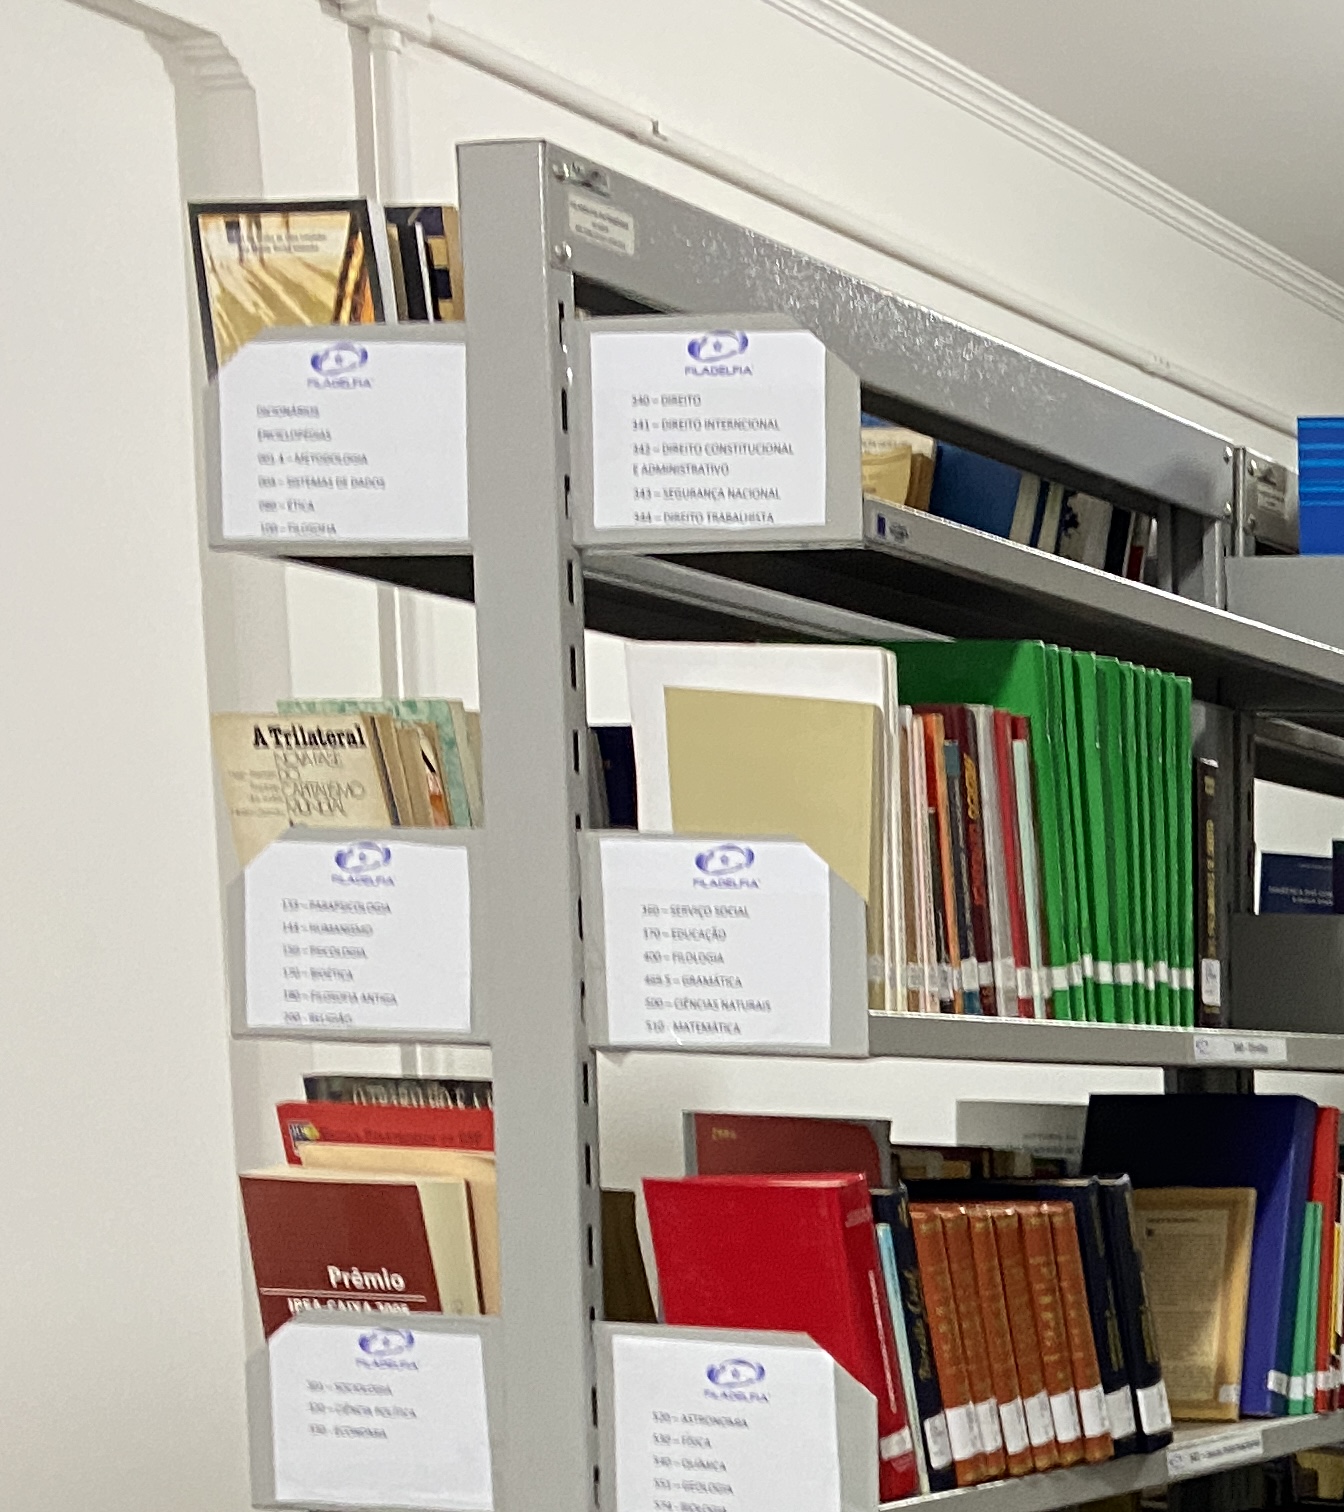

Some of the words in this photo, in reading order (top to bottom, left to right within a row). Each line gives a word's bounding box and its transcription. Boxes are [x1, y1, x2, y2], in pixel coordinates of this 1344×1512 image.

[685, 365, 752, 376] FILADELFIA
[253, 724, 268, 749] A
[268, 722, 367, 749] Trilateral
[327, 1265, 405, 1291] Prêmio
